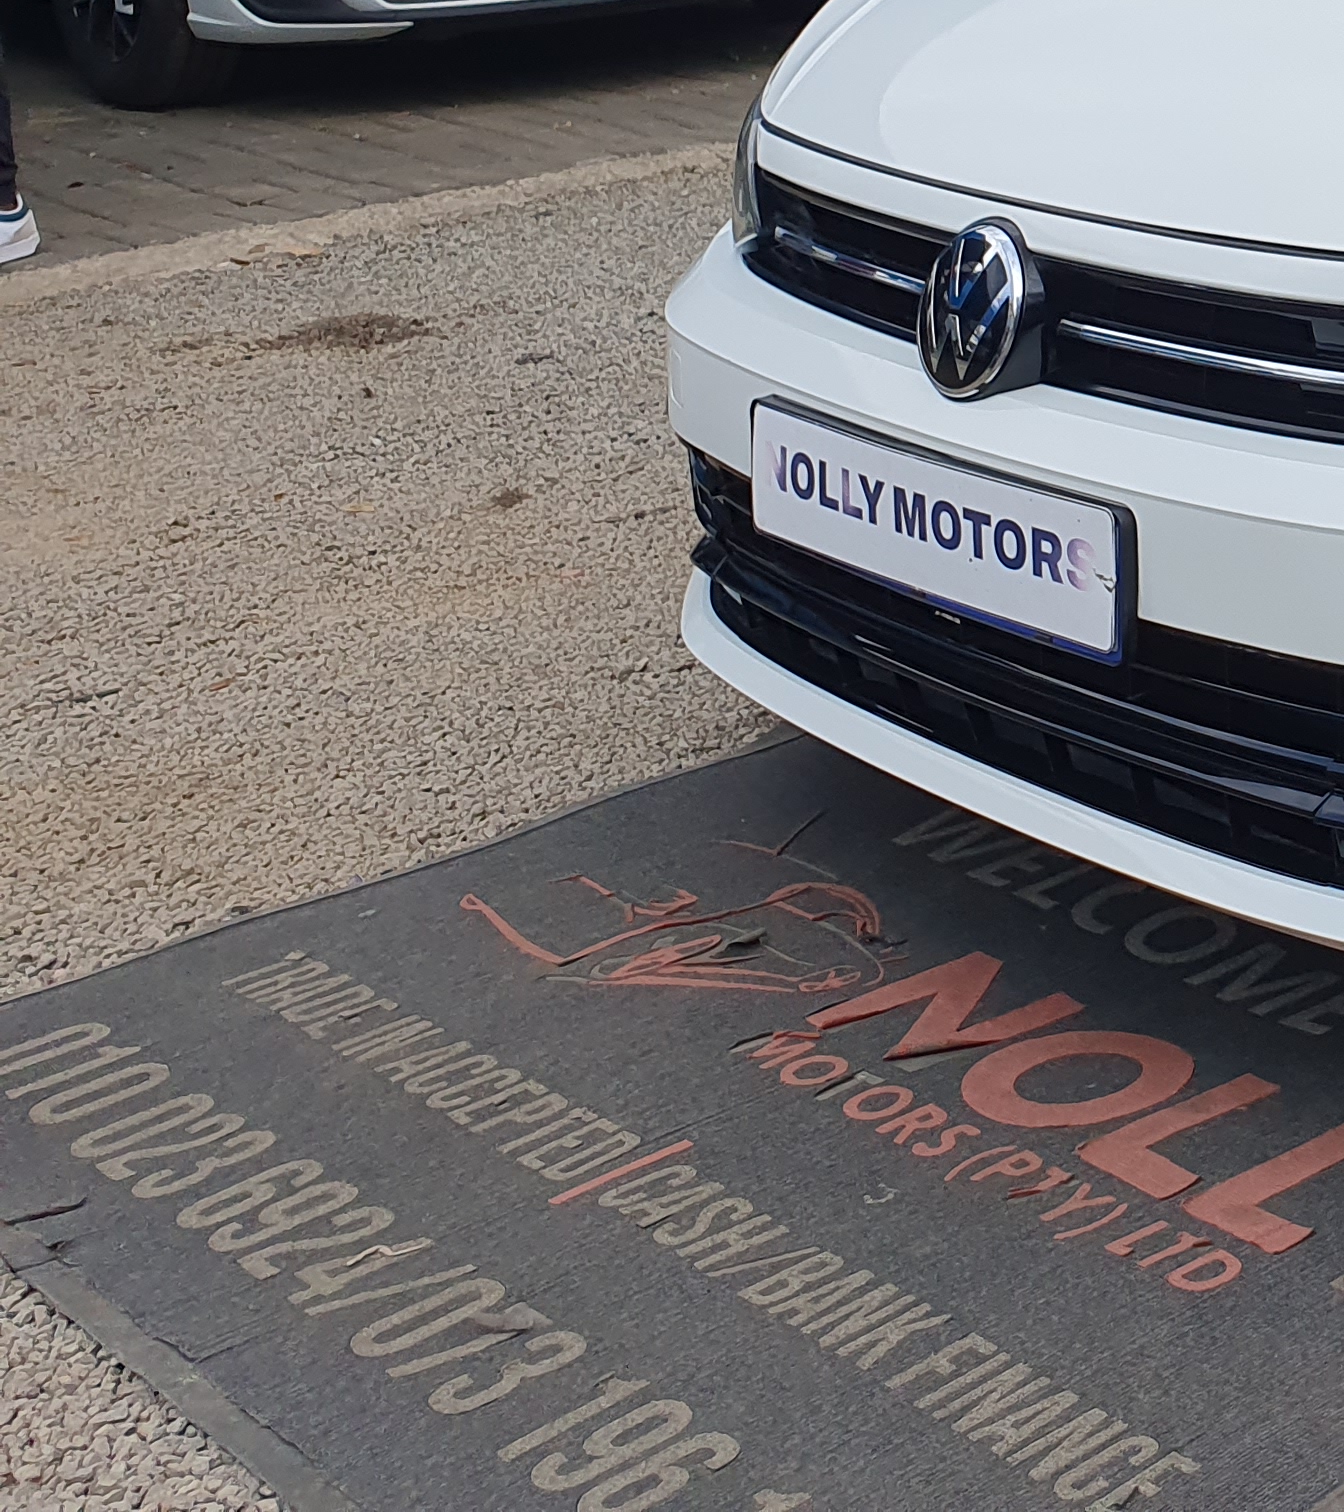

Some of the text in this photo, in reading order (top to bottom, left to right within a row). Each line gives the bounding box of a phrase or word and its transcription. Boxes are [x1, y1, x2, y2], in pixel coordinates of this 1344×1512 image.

[765, 440, 1098, 591] NOLLY MOTORS
[0, 1022, 172, 1125] 010
[70, 1093, 277, 1199] 023
[221, 949, 399, 1040] TRADE
[884, 1331, 1203, 1512] FINANCE
[730, 1029, 1243, 1293] MOTORS (PTY) LTD
[497, 1371, 742, 1512] 196
